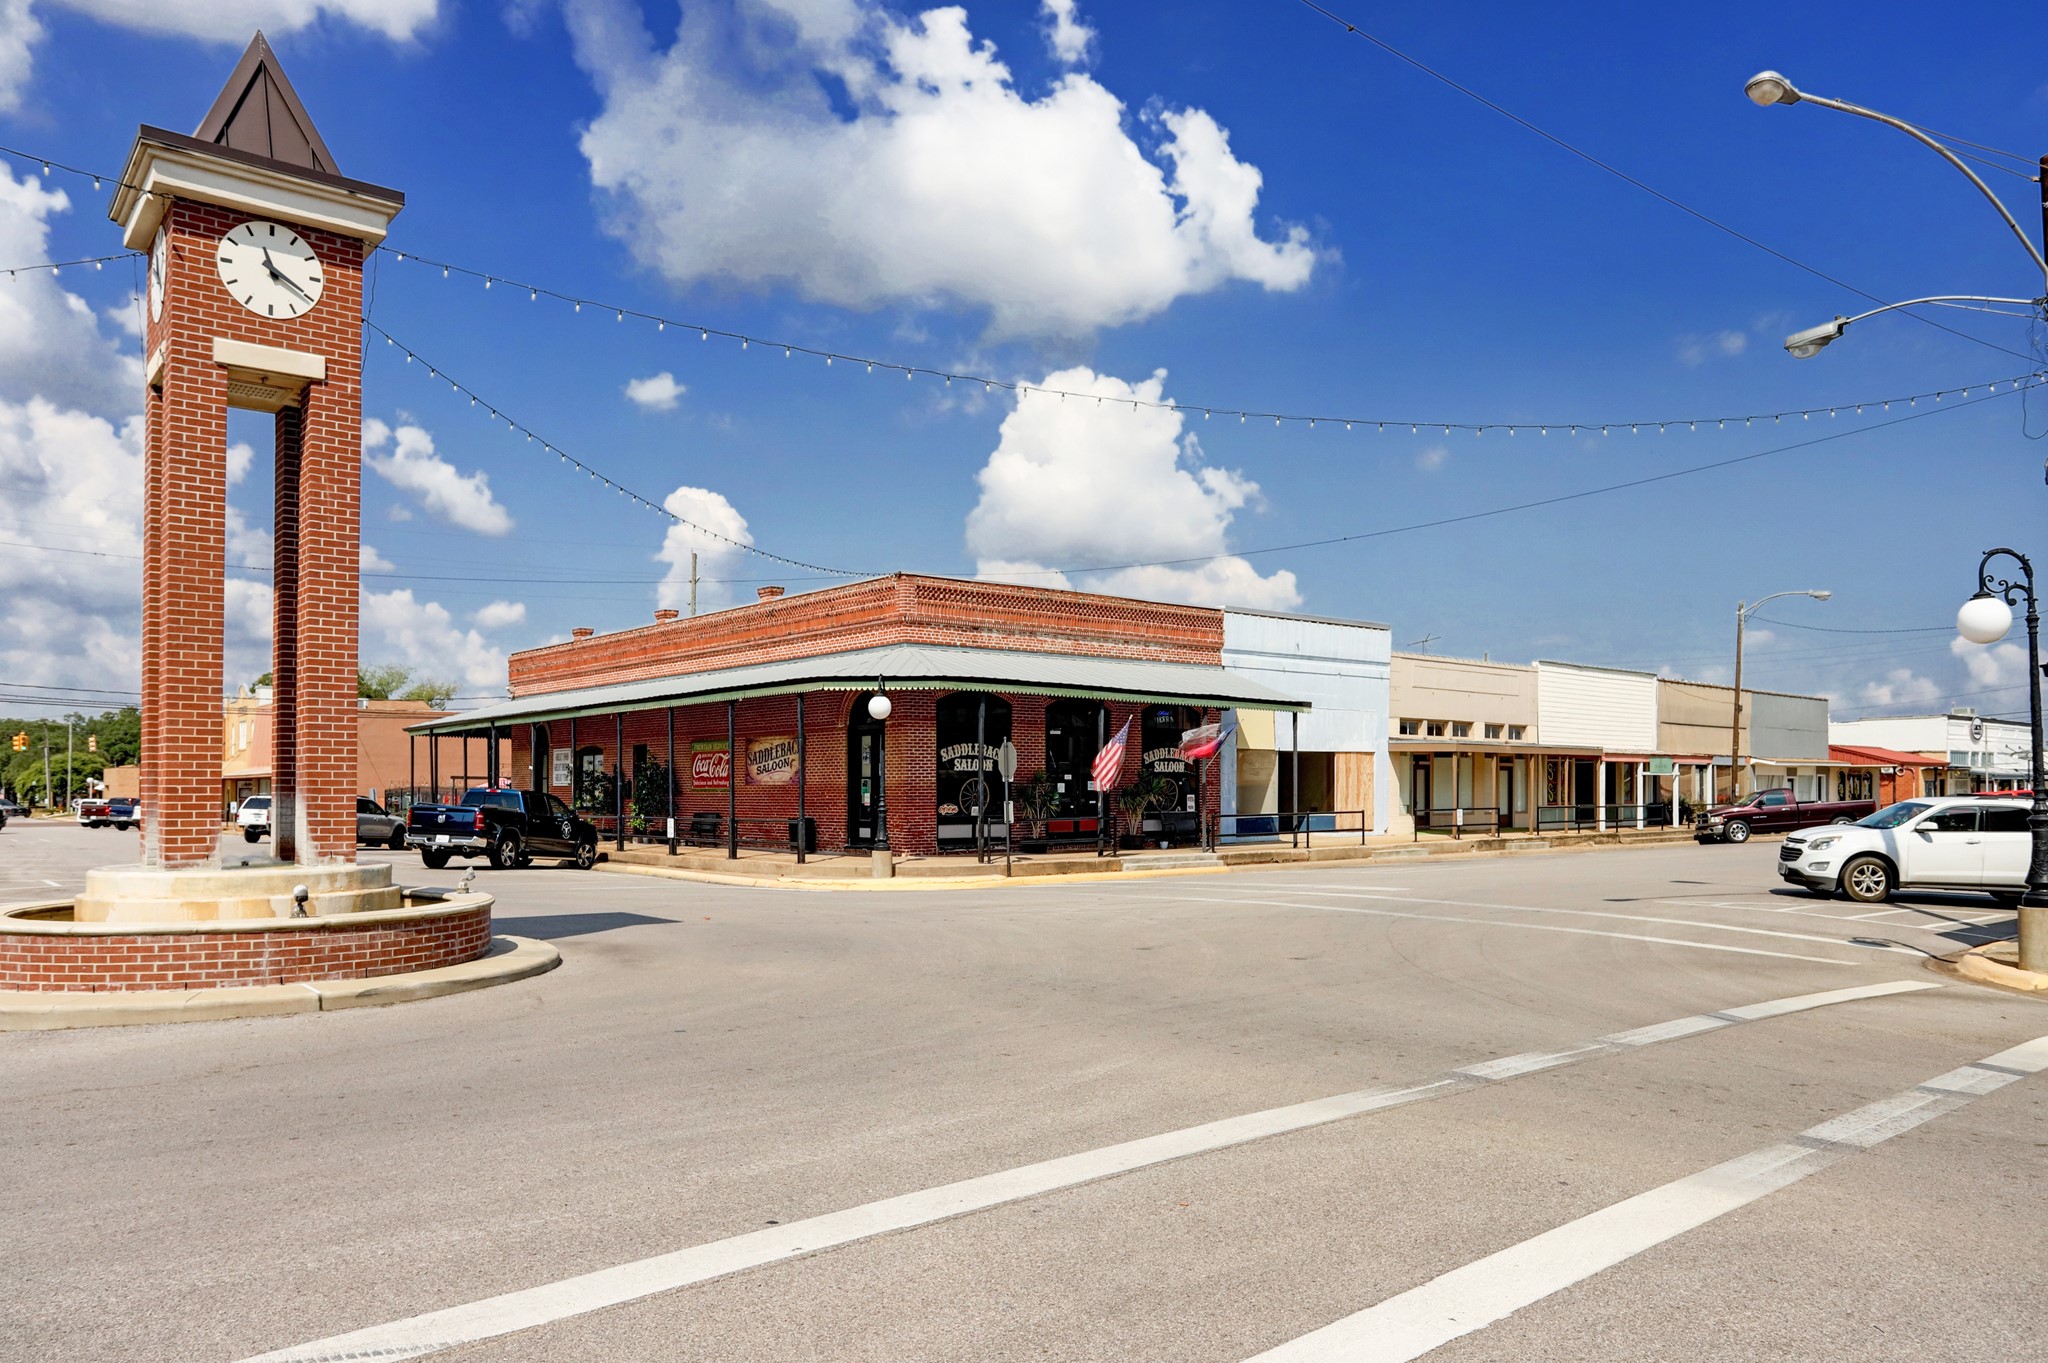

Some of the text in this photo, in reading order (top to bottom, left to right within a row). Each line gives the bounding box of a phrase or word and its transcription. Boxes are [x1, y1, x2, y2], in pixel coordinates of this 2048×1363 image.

[940, 743, 1000, 762] SADDLEBAC
[756, 757, 790, 775] SALOON
[954, 759, 993, 771] SALON
[1153, 761, 1185, 773] SALOON
